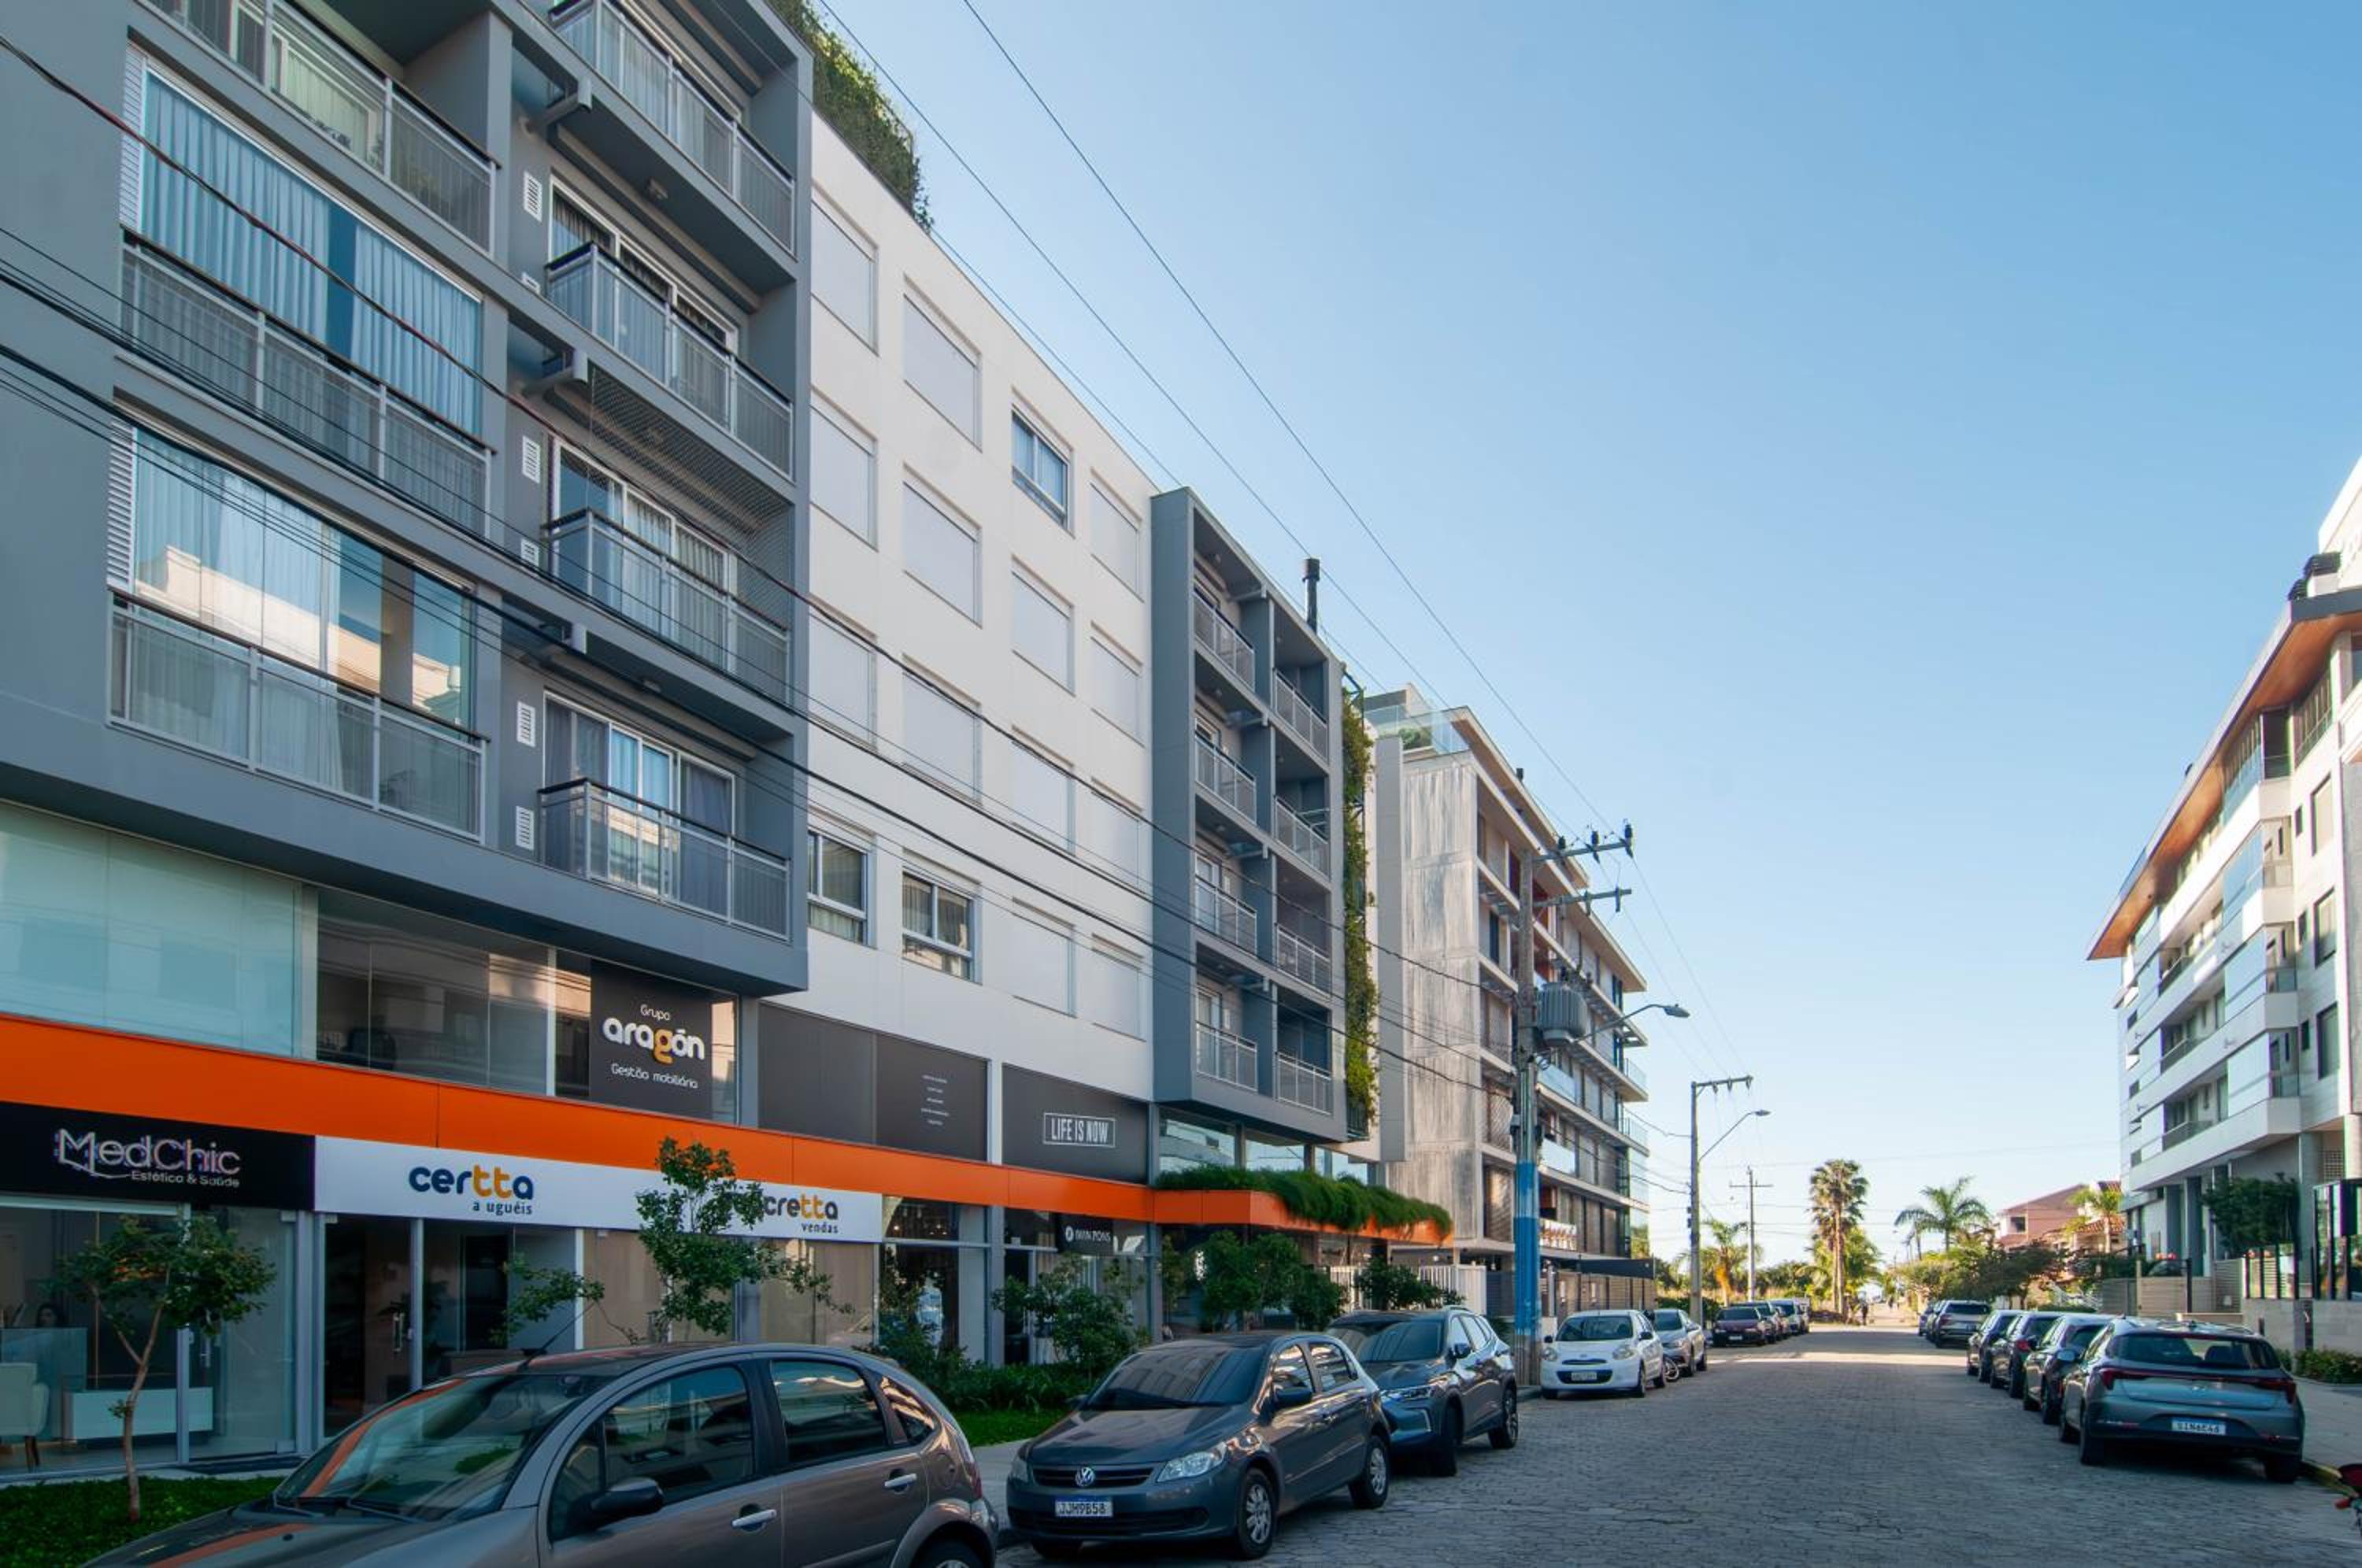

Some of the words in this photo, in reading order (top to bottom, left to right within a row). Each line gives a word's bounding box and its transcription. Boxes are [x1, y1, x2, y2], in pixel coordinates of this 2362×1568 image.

[640, 1004, 671, 1021] Grupo
[602, 1017, 705, 1064] aragón
[611, 1063, 650, 1080] Gestão
[1051, 1117, 1072, 1141] LIFE
[1075, 1119, 1084, 1142] IS
[1087, 1120, 1109, 1144] NOW
[58, 1128, 240, 1176] MedChic
[131, 1170, 183, 1184] Estética
[187, 1172, 197, 1185] &
[200, 1173, 239, 1188] Saúde
[409, 1164, 534, 1200] certta
[723, 1191, 839, 1220] cretta
[801, 1221, 839, 1234] vendas
